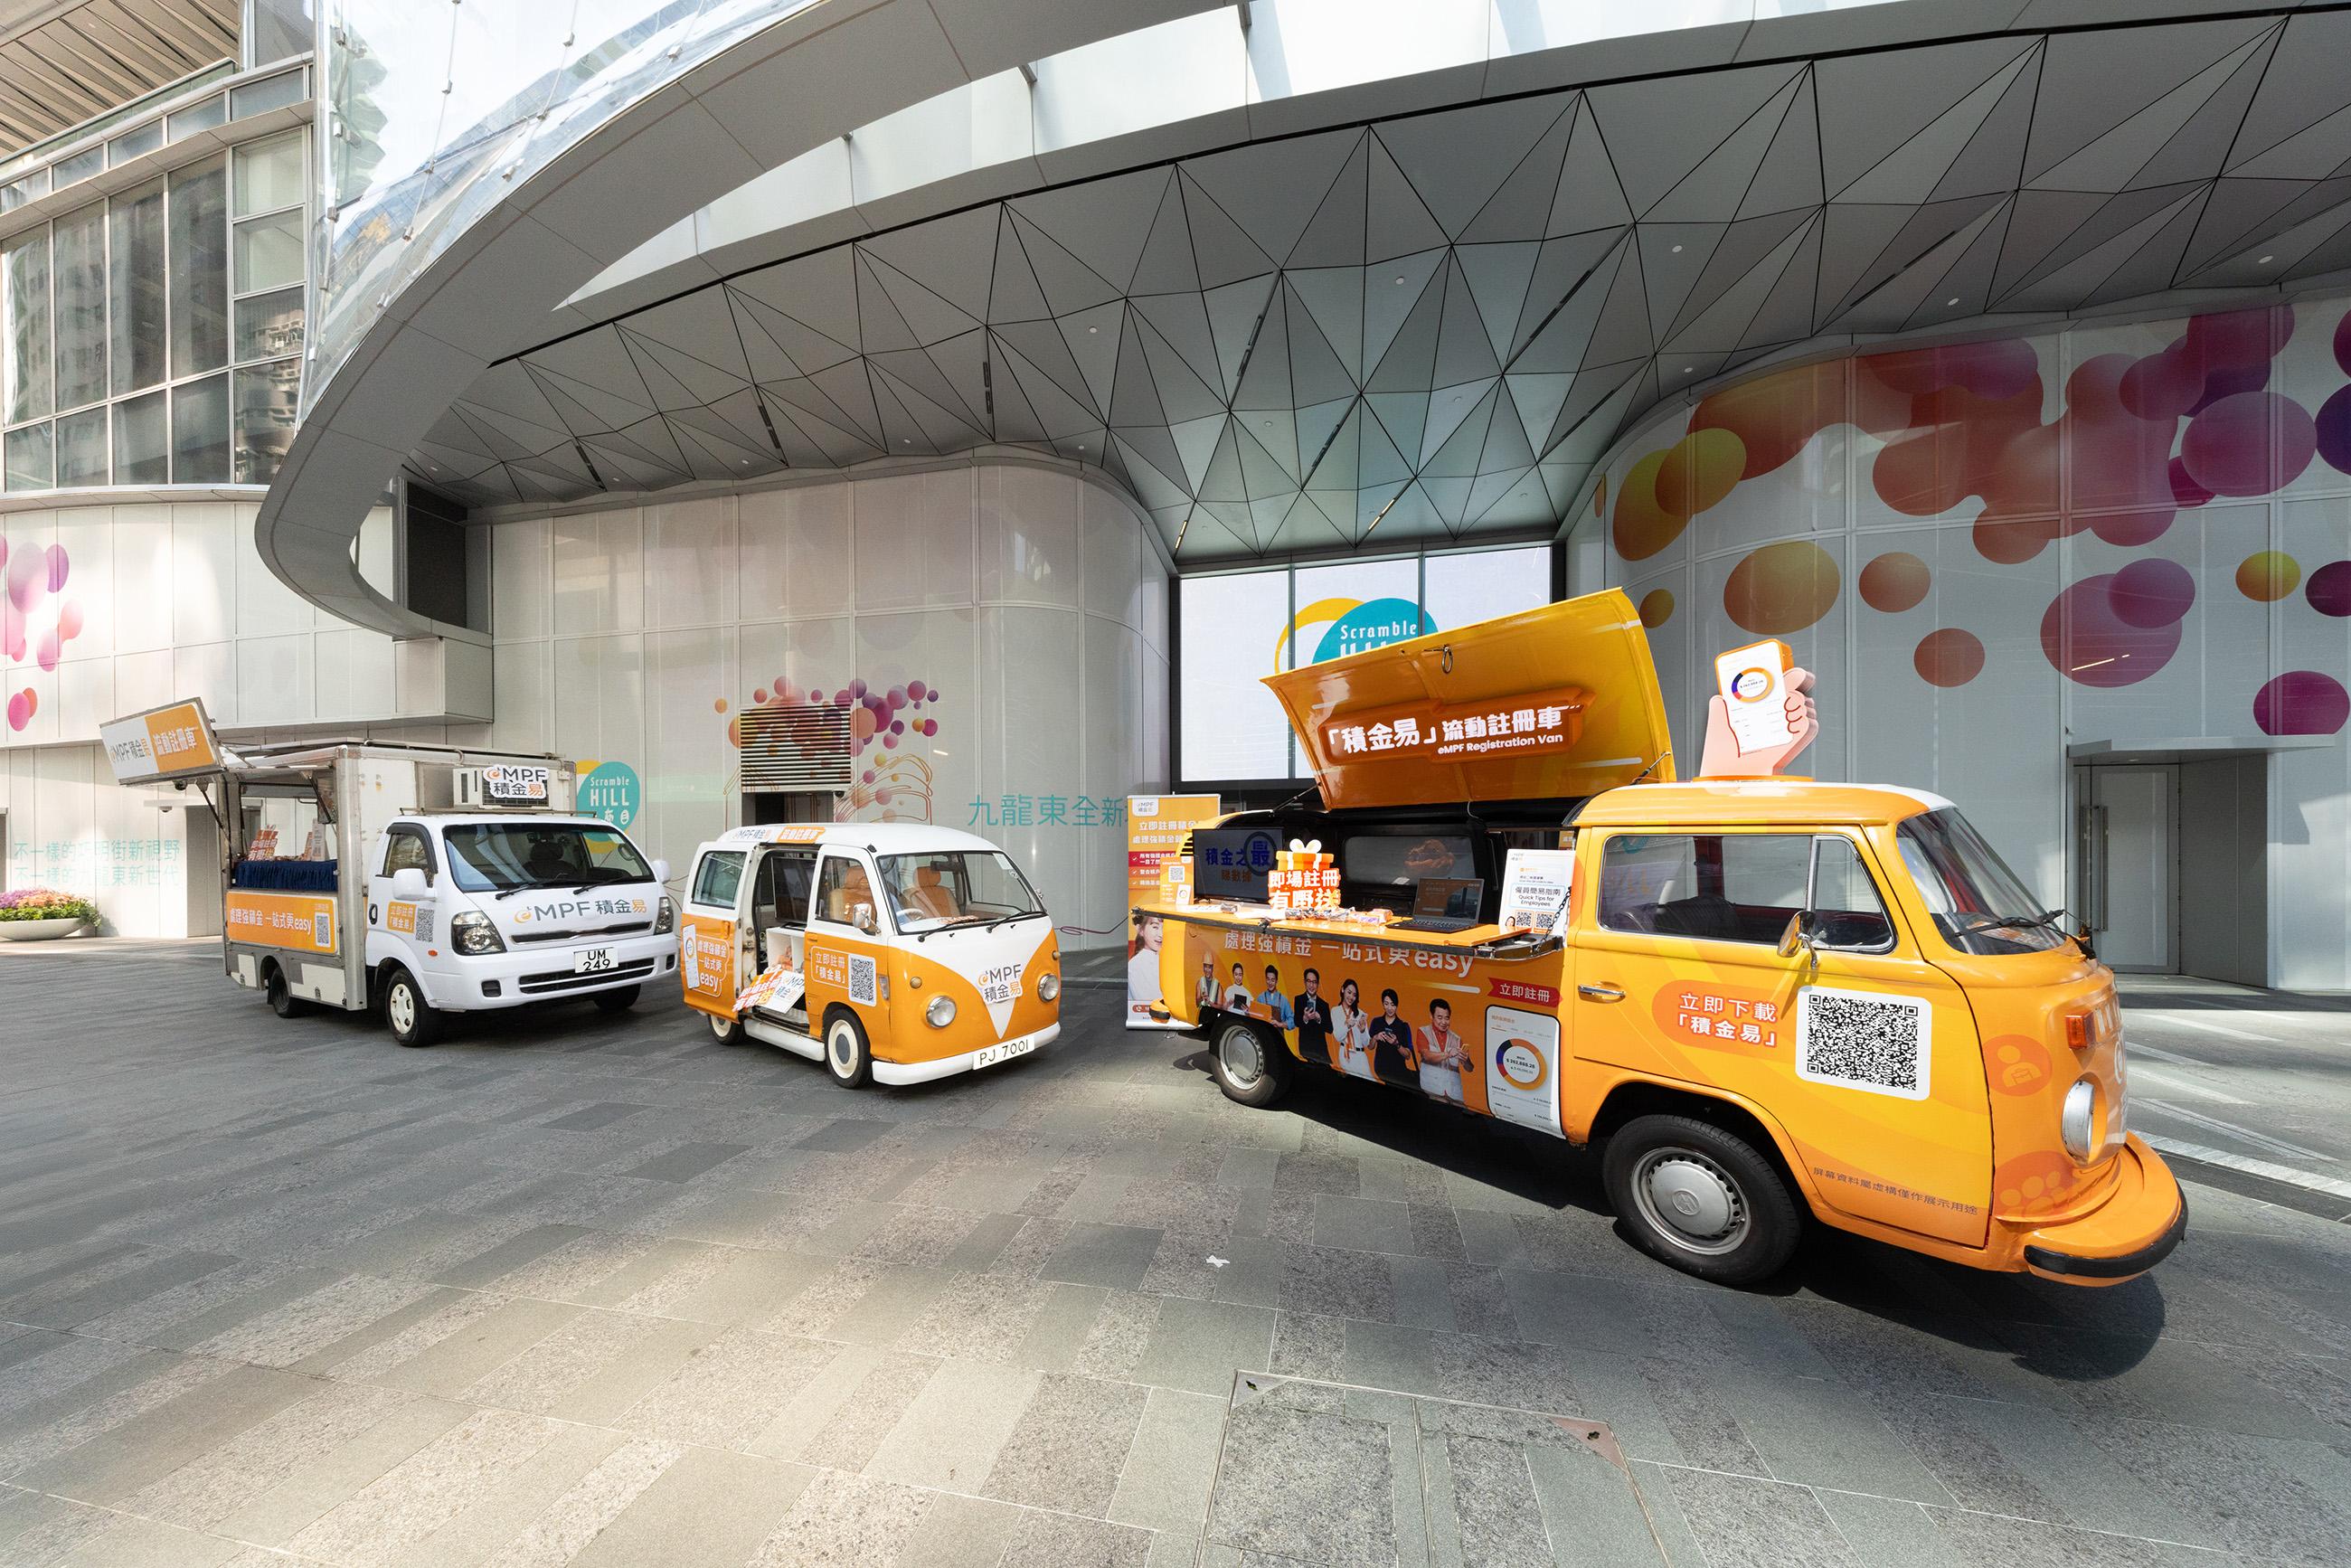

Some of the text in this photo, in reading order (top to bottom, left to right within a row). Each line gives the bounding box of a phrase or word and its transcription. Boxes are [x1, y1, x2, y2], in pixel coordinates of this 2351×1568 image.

[1340, 620, 1418, 639] Scramble
[1328, 706, 1571, 754] 「積金易」 流動註冊車
[1438, 733, 1563, 755] eMPF Registration Van
[494, 782, 543, 797] 積金易
[590, 776, 630, 787] Scramble
[590, 789, 630, 807] HILL
[1268, 870, 1339, 888] 即場註冊
[595, 899, 647, 915] 積金易
[1520, 899, 1551, 907] Employees
[1224, 930, 1312, 957] 處理強積金
[587, 949, 607, 961] UM
[582, 959, 611, 972] 249
[699, 972, 720, 992] easy
[984, 981, 1022, 1002] 積金易
[1499, 983, 1550, 1003] 立即註冊
[1679, 993, 1778, 1022] 立即下載
[1678, 1013, 1777, 1046] 「積金易」
[979, 1049, 996, 1065] PJ
